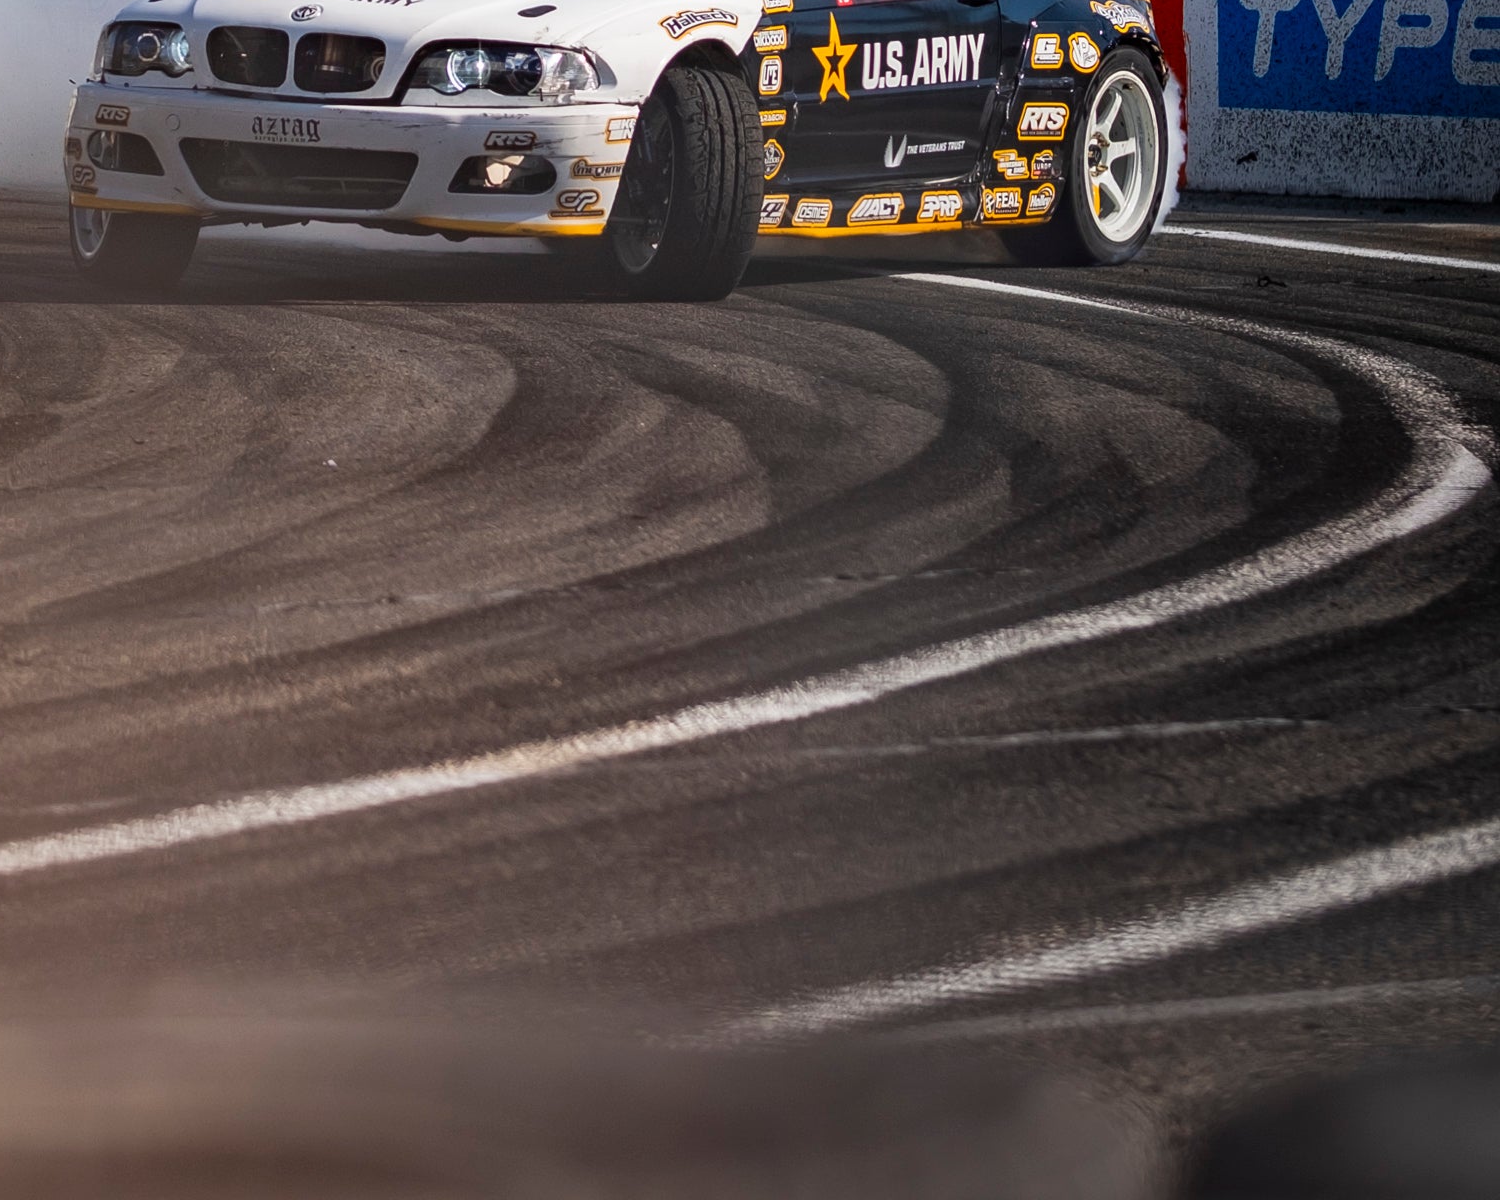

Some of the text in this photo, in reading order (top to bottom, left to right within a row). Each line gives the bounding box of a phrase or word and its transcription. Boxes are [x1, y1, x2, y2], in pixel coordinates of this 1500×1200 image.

[667, 9, 736, 35] Haltech
[862, 33, 986, 90] U.S. ARMY
[97, 106, 130, 122] RTS
[1020, 107, 1067, 131] RTS
[252, 115, 321, 143] azrag
[487, 132, 535, 147] RTS
[907, 140, 966, 155] THE VETERANS TRUST
[559, 191, 598, 212] CP
[920, 195, 961, 217] PRP
[996, 192, 1020, 208] FEAL
[1030, 194, 1052, 208] Holley
